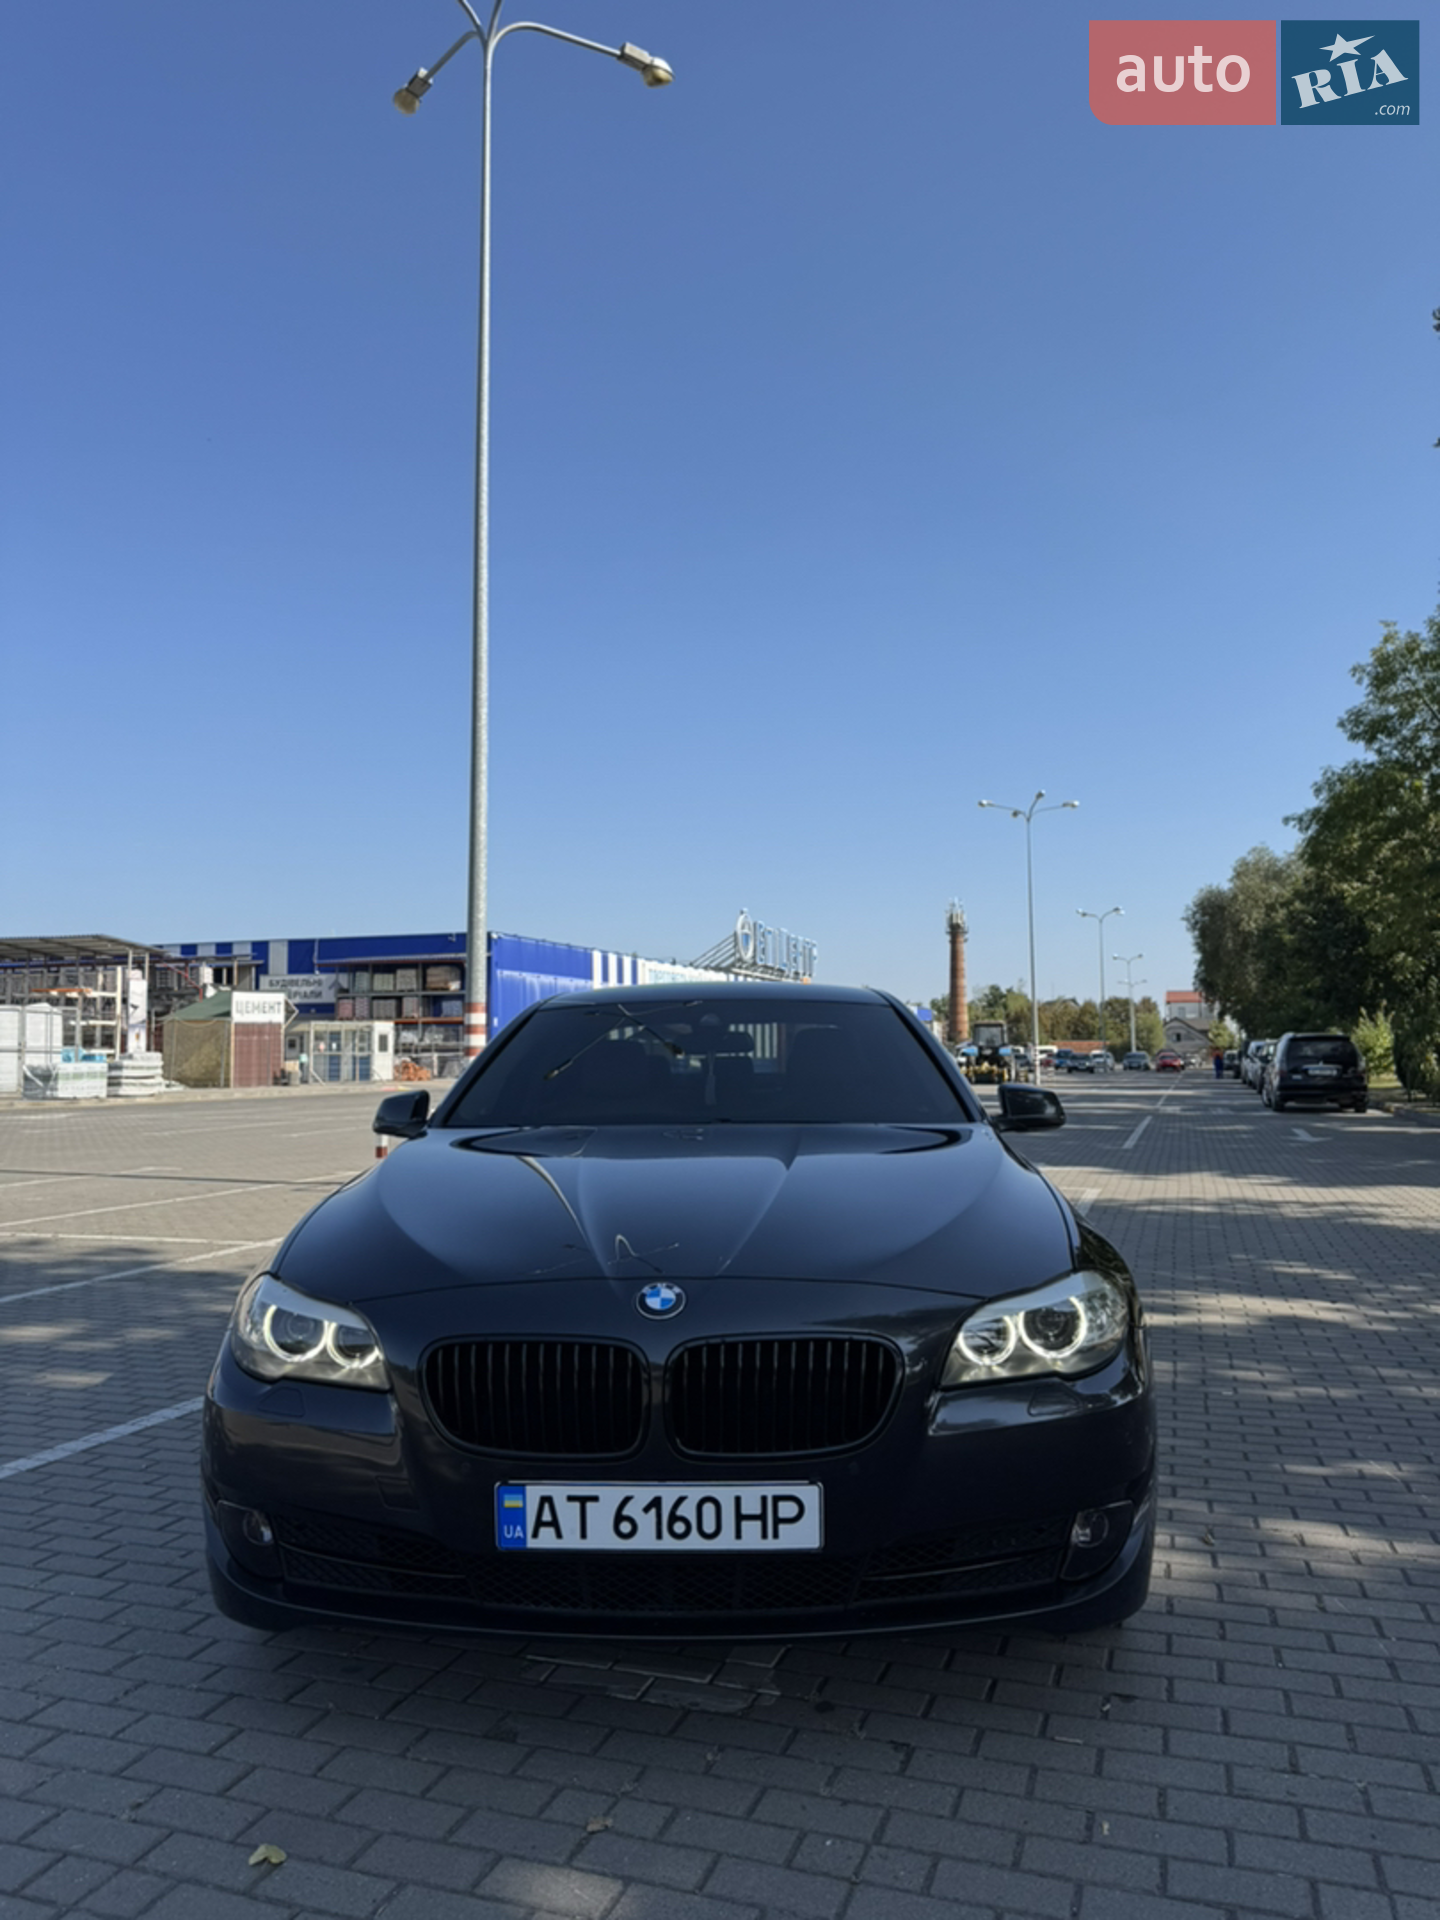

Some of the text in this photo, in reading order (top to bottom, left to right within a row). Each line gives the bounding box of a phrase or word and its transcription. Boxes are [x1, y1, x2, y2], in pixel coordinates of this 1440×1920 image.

[235, 1001, 283, 1016] ЦЕМЕНТ
[530, 1495, 806, 1540] AT 6160 HP
[503, 1525, 525, 1539] UA
